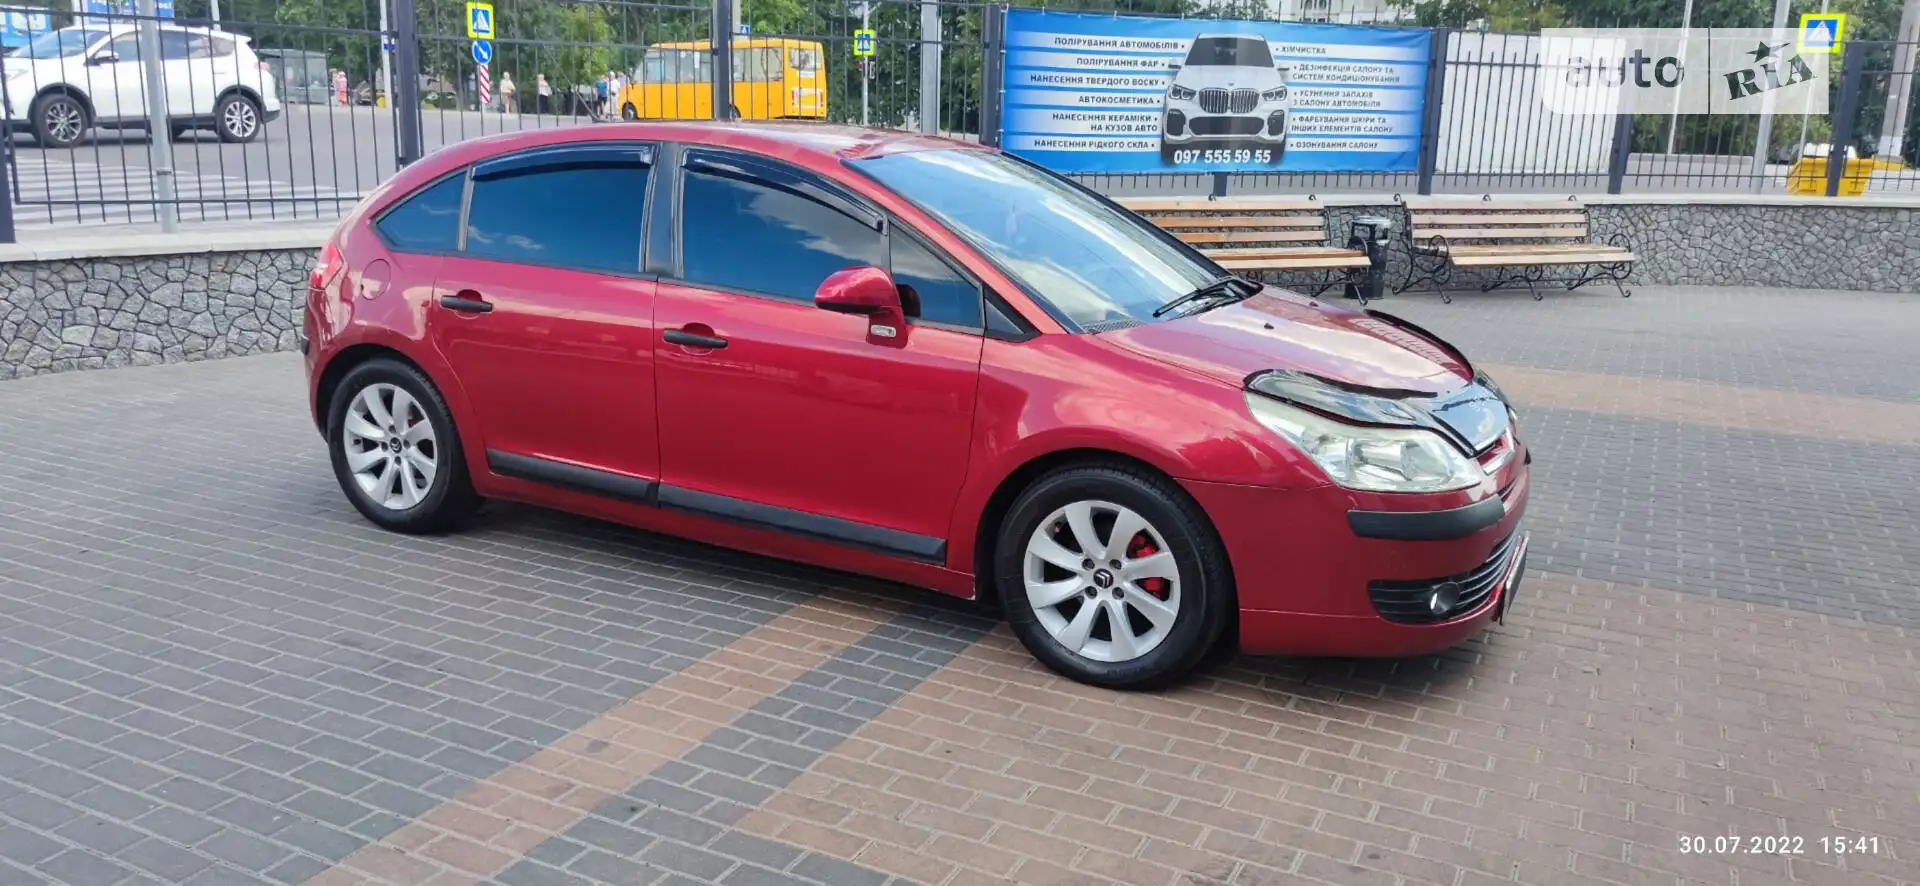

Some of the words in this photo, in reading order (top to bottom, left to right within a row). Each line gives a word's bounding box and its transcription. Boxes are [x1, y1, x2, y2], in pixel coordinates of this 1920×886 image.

[1054, 37, 1118, 48] ПОЛІРУВАННЯ
[1119, 40, 1179, 50] АВТОМОБІЛІВ
[1281, 46, 1327, 55] ХІМЧИСТКА
[1076, 57, 1138, 68] ПОЛІРУВАННЯ
[1140, 60, 1159, 68] ФАР
[1352, 66, 1383, 74] САЛОНУ
[1030, 75, 1083, 84] НАНЕСЕННЯ
[1085, 76, 1130, 87] ТВЕРДОГО
[1131, 78, 1159, 87] ВОСКУ
[1292, 73, 1324, 81] СИСТЕМ
[1078, 95, 1154, 105] АВТОКОСМЕТИКА
[1299, 99, 1331, 107] САЛОНУ
[1052, 112, 1106, 122] НАНЕСЕННЯ
[1108, 114, 1151, 122] КЕРАМІКИ
[1090, 124, 1103, 132] НА
[1105, 124, 1133, 132] КУЗОВ
[1135, 124, 1158, 132] АВТО
[1034, 139, 1087, 149] НАНЕСЕННЯ
[1088, 140, 1125, 149] РІДКОГО
[1126, 141, 1149, 149] СКЛА
[1348, 142, 1379, 150] САЛОНУ
[1173, 149, 1200, 164] 097
[1204, 149, 1232, 164] 555
[1234, 149, 1251, 164] 59
[1254, 149, 1272, 164] 55
